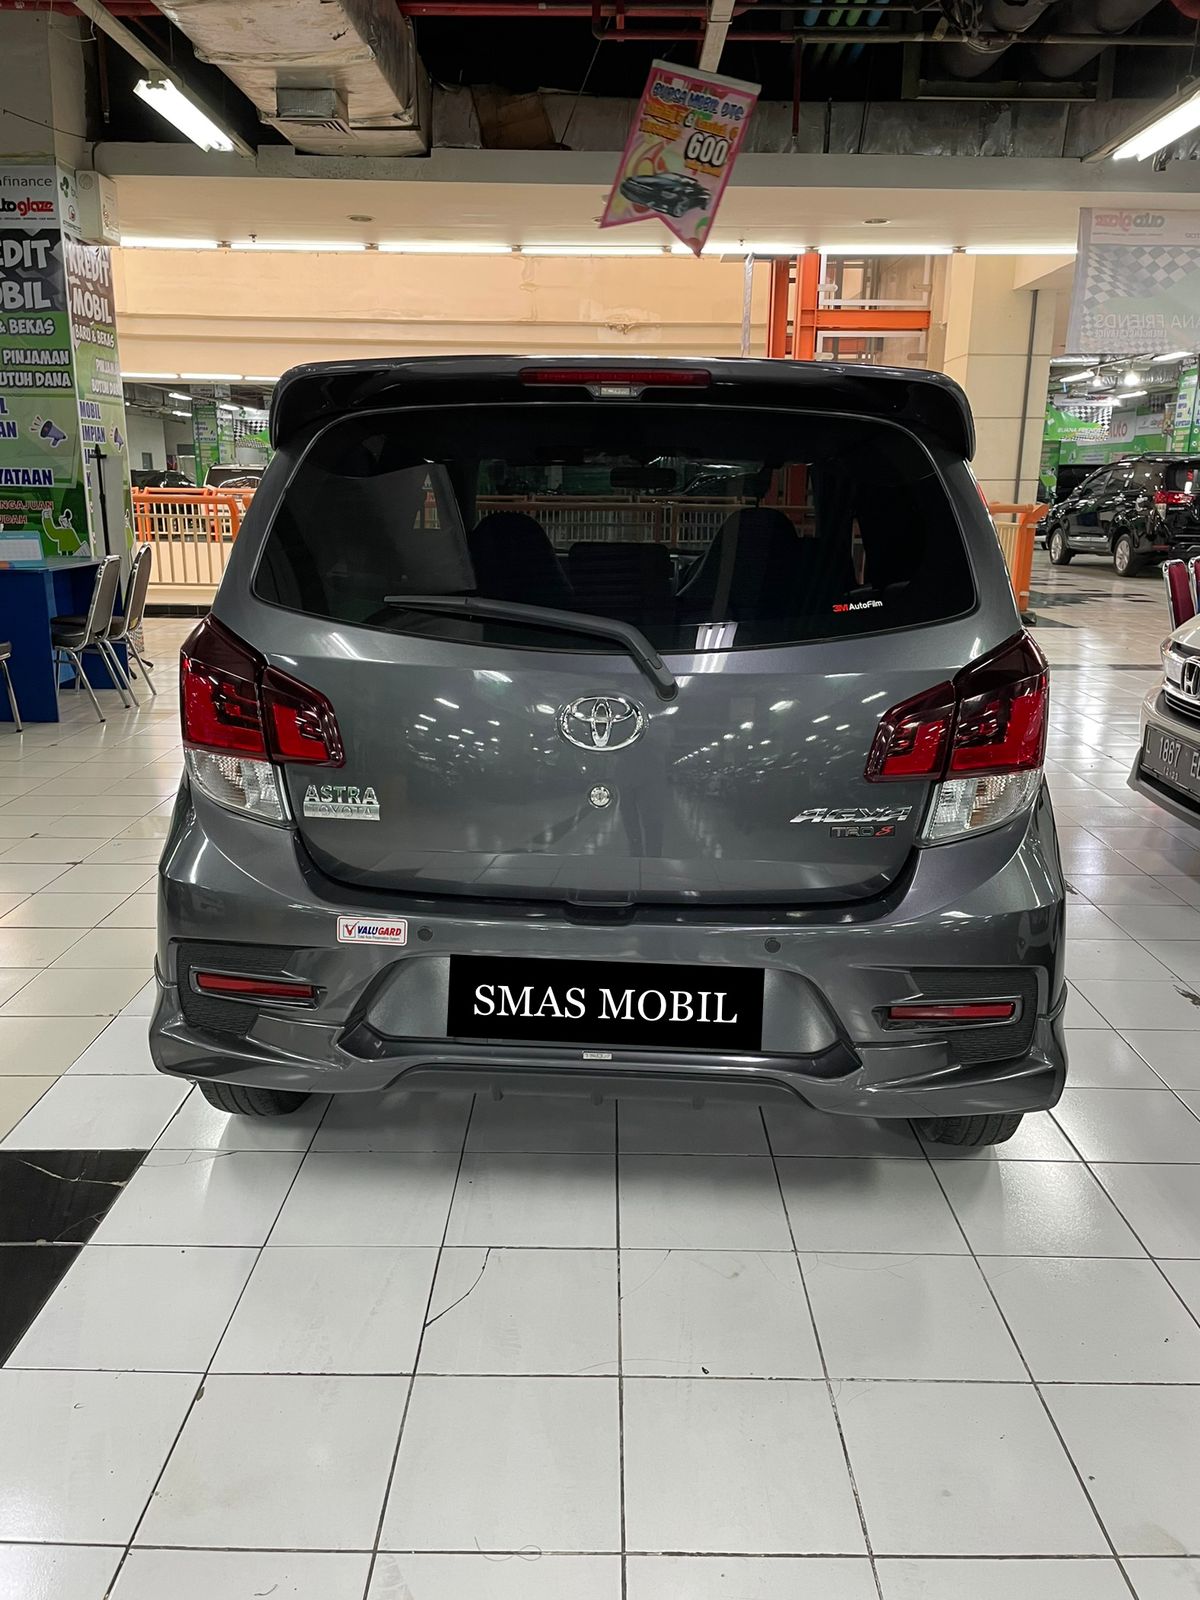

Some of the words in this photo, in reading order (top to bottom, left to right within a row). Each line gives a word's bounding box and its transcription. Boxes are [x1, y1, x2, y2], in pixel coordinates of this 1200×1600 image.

[685, 132, 728, 167] 600
[0, 239, 51, 269] DIT
[0, 281, 52, 309] BIL
[72, 287, 113, 324] MOBIL
[9, 319, 55, 335] BEKAS
[3, 350, 70, 365] PINJAMAN
[35, 372, 71, 387] DANA
[79, 400, 101, 419] MOBIL
[82, 424, 106, 443] IMPIAN
[1159, 736, 1182, 768] 1867
[304, 784, 379, 805] ASTRA
[306, 804, 374, 818] TOYOTA
[357, 925, 402, 937] VALUGARD
